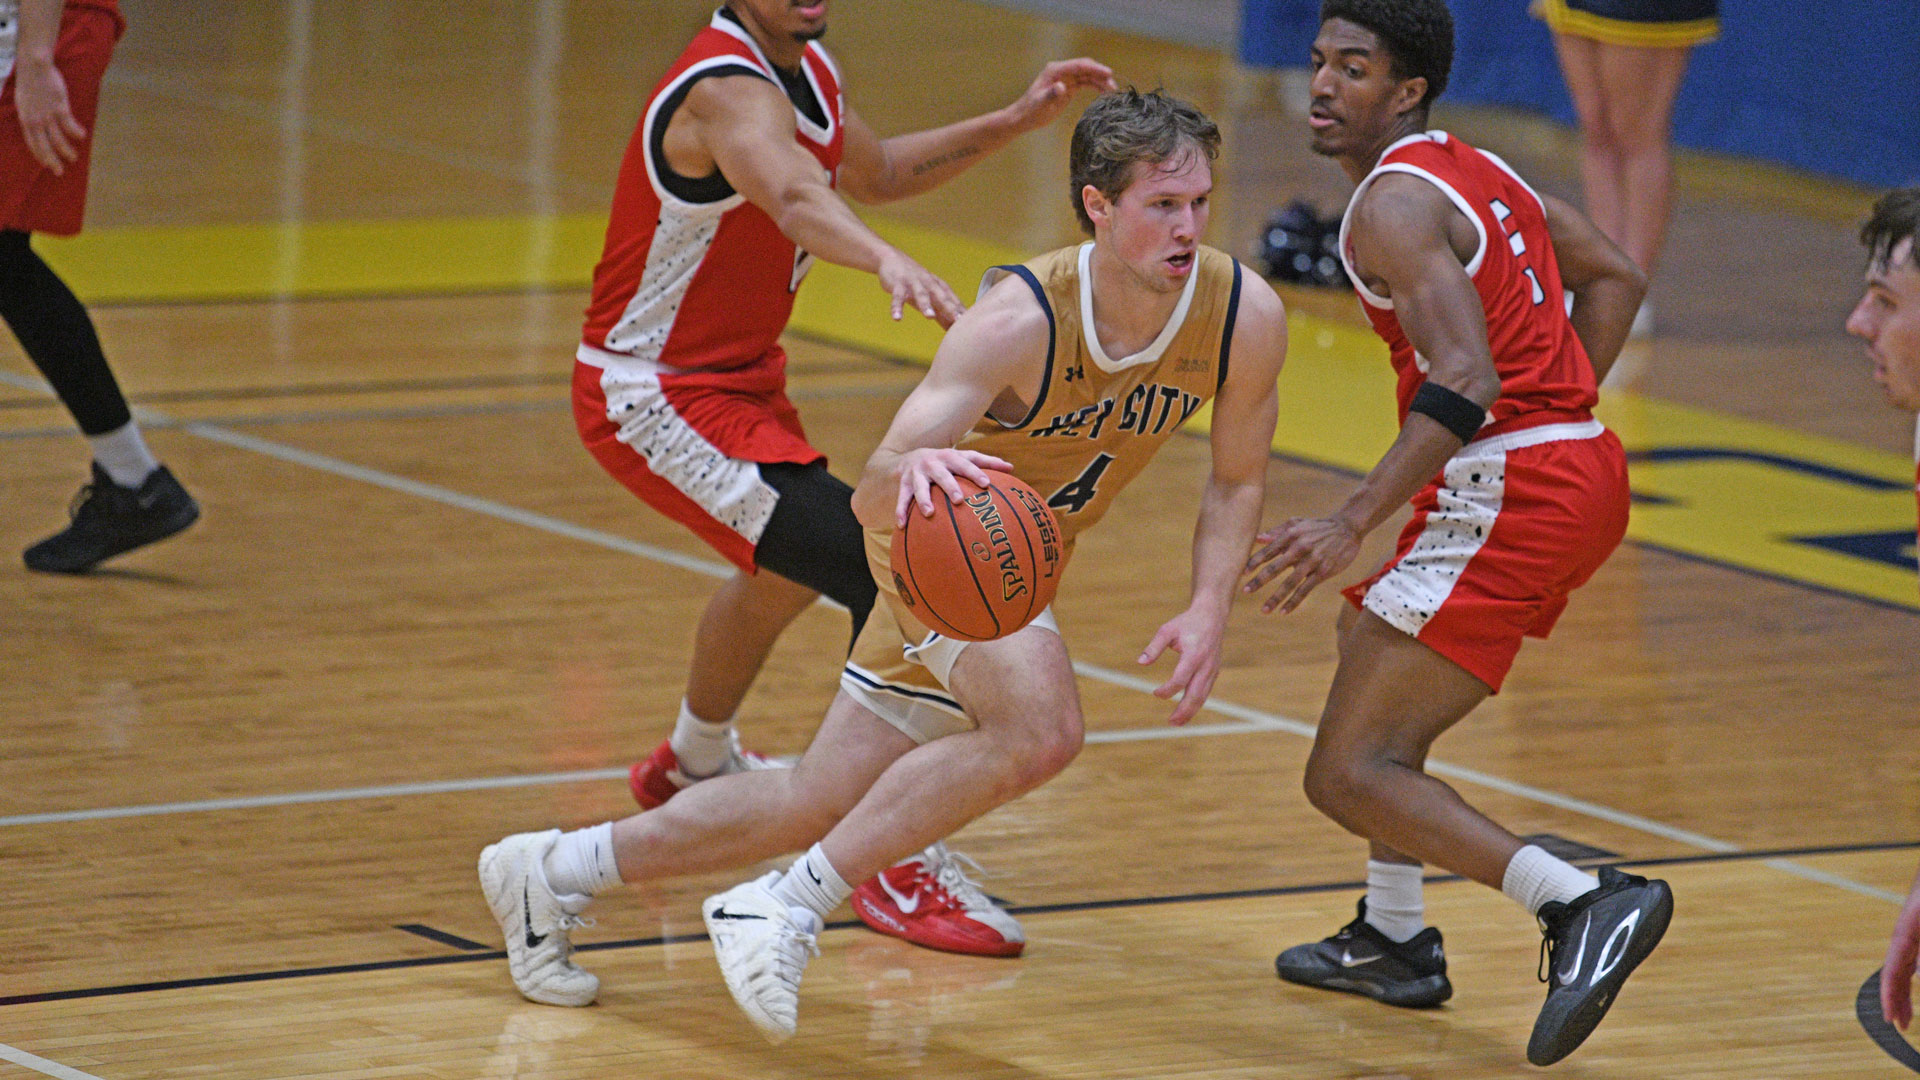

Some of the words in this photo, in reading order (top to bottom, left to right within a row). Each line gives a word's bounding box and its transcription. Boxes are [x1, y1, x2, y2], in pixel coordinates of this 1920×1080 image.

[1117, 383, 1201, 435] CITY
[1047, 451, 1116, 515] 4
[964, 490, 1028, 602] SPALDING
[1009, 487, 1054, 578] LEGACY
